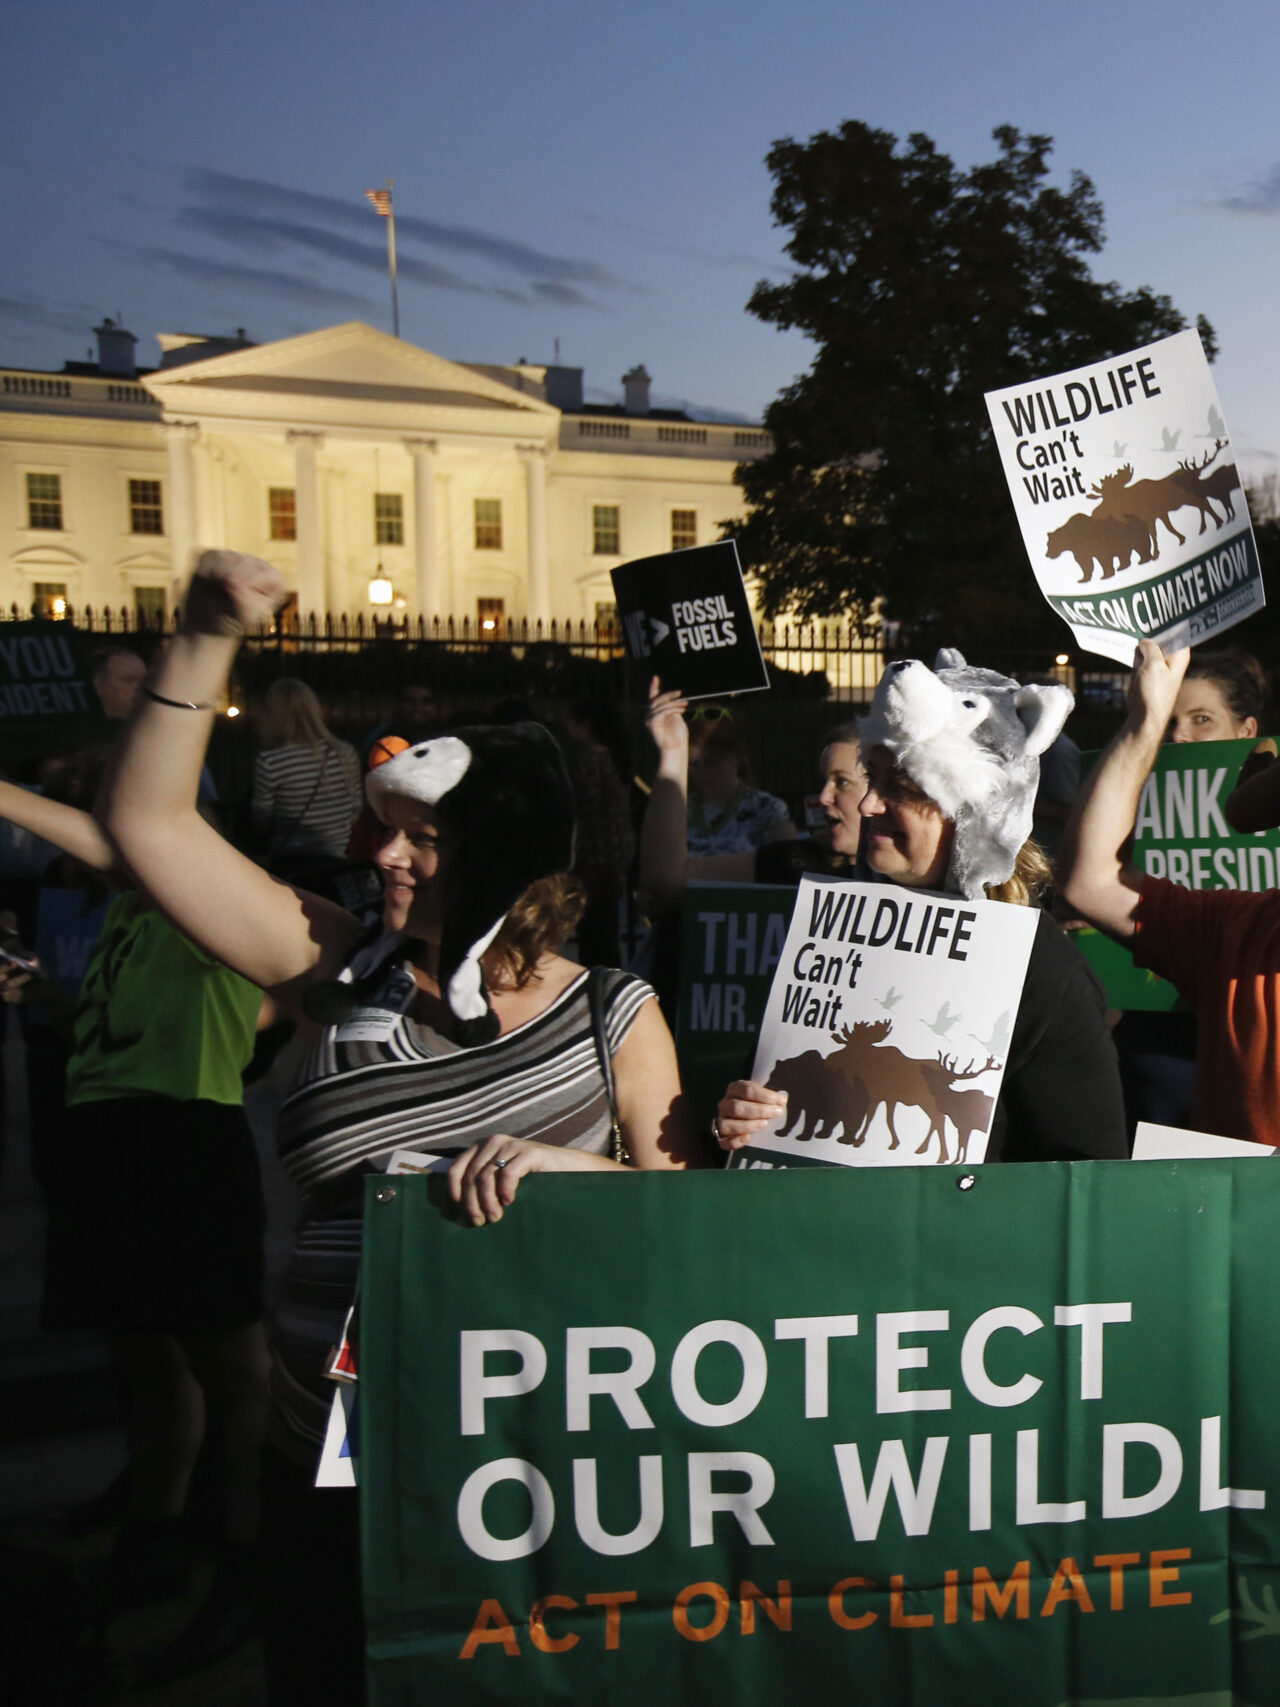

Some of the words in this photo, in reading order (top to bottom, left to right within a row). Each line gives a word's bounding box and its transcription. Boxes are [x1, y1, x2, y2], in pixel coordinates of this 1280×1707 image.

[1001, 357, 1161, 438] WILDLIFE
[1015, 430, 1084, 471] Can't
[1022, 466, 1087, 505] Wait
[671, 595, 735, 628] FOSSIL
[1060, 599, 1100, 628] ACT
[1099, 602, 1136, 633] ON
[1131, 568, 1208, 634] CLIMATE
[1204, 540, 1250, 591] NOW
[0, 634, 75, 679] YOU
[676, 620, 738, 654] FUELS
[1134, 767, 1231, 840] ANK
[697, 911, 787, 977] THA
[808, 888, 978, 962] WILDLIFE
[792, 942, 863, 989] Can't
[689, 982, 756, 1033] MR.
[781, 983, 842, 1032] Wait
[459, 1301, 1133, 1436] PROTECT
[456, 1451, 776, 1561] OUR
[457, 1588, 638, 1659] ACT
[671, 1580, 793, 1641] ON
[827, 1546, 1194, 1631] CLIMATE
